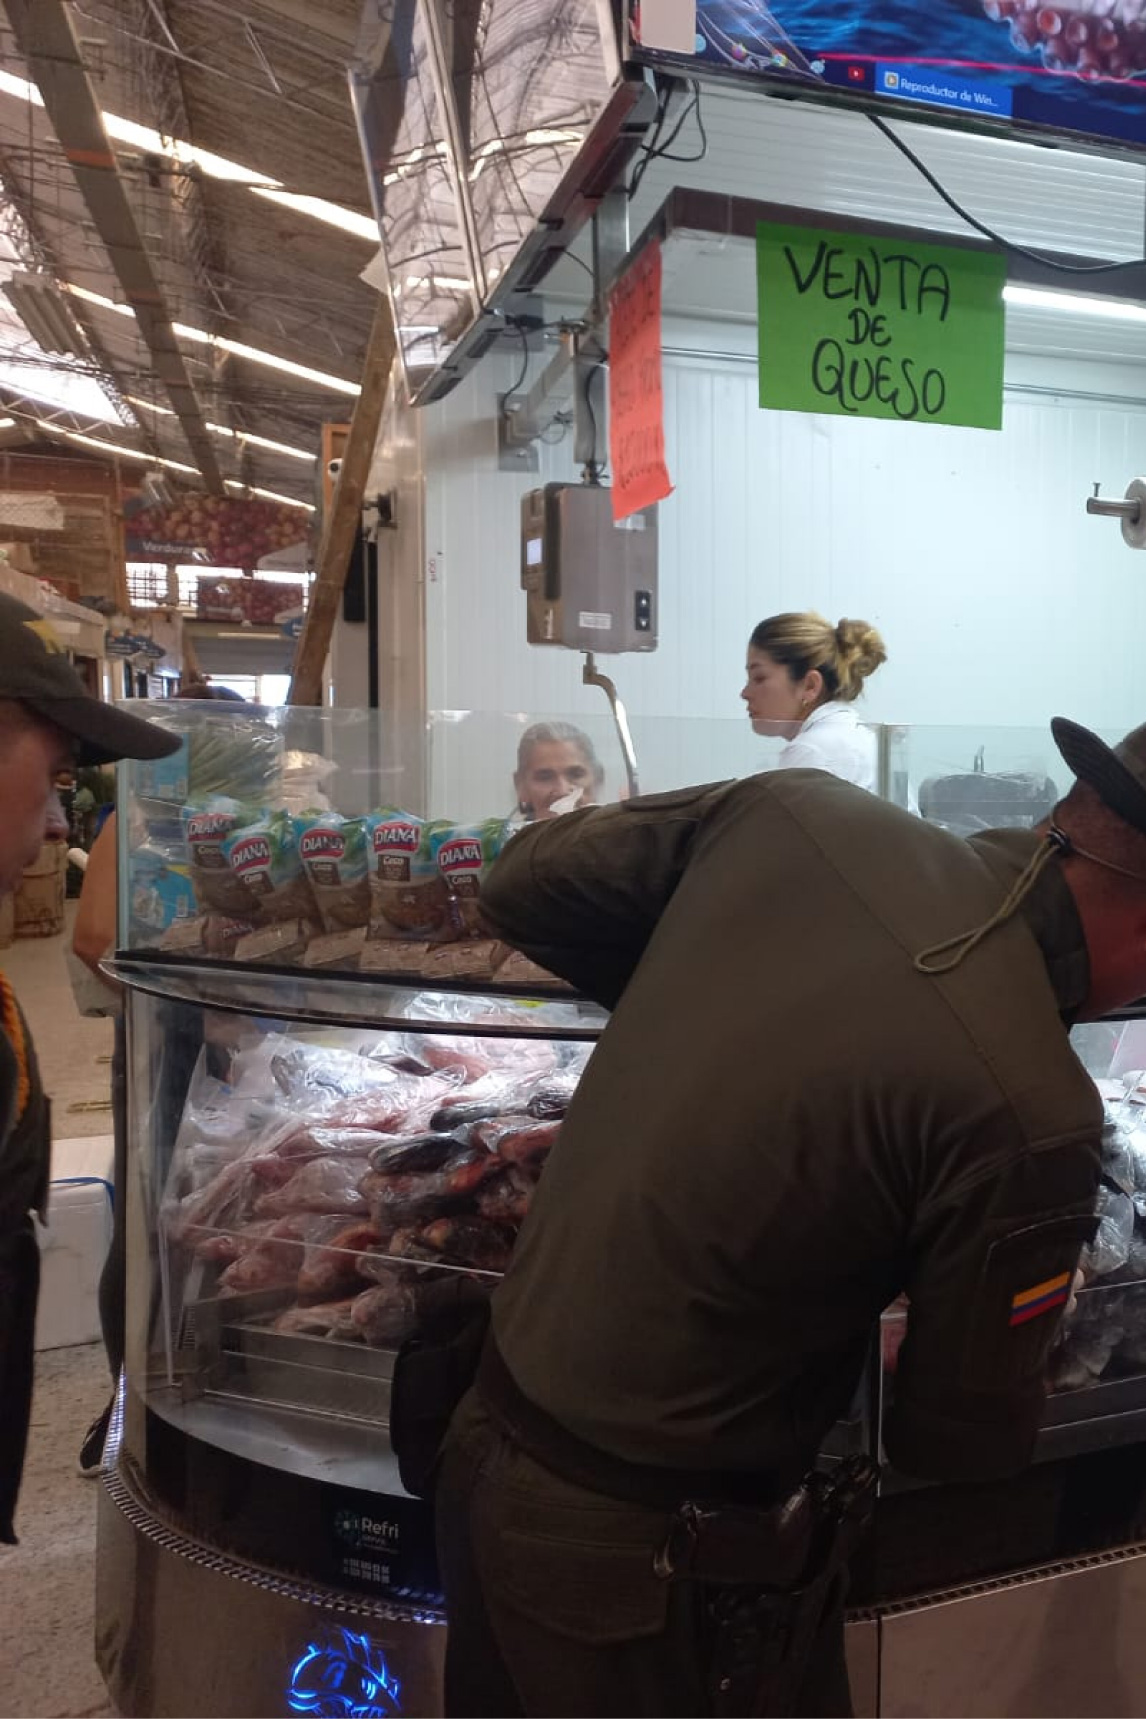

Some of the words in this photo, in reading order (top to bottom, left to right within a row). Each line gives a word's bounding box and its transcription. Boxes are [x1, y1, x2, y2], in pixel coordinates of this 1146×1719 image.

[901, 78, 958, 99] Reproductor
[960, 91, 972, 102] de
[783, 241, 950, 322] VENTA
[846, 307, 892, 346] DE
[812, 338, 946, 419] QUESO
[190, 818, 235, 835] DIANA
[375, 826, 417, 846] DIANA
[232, 843, 268, 868] DIANA
[301, 836, 344, 852] DIANA
[440, 844, 482, 866] DIANA
[361, 1517, 399, 1539] Refri
